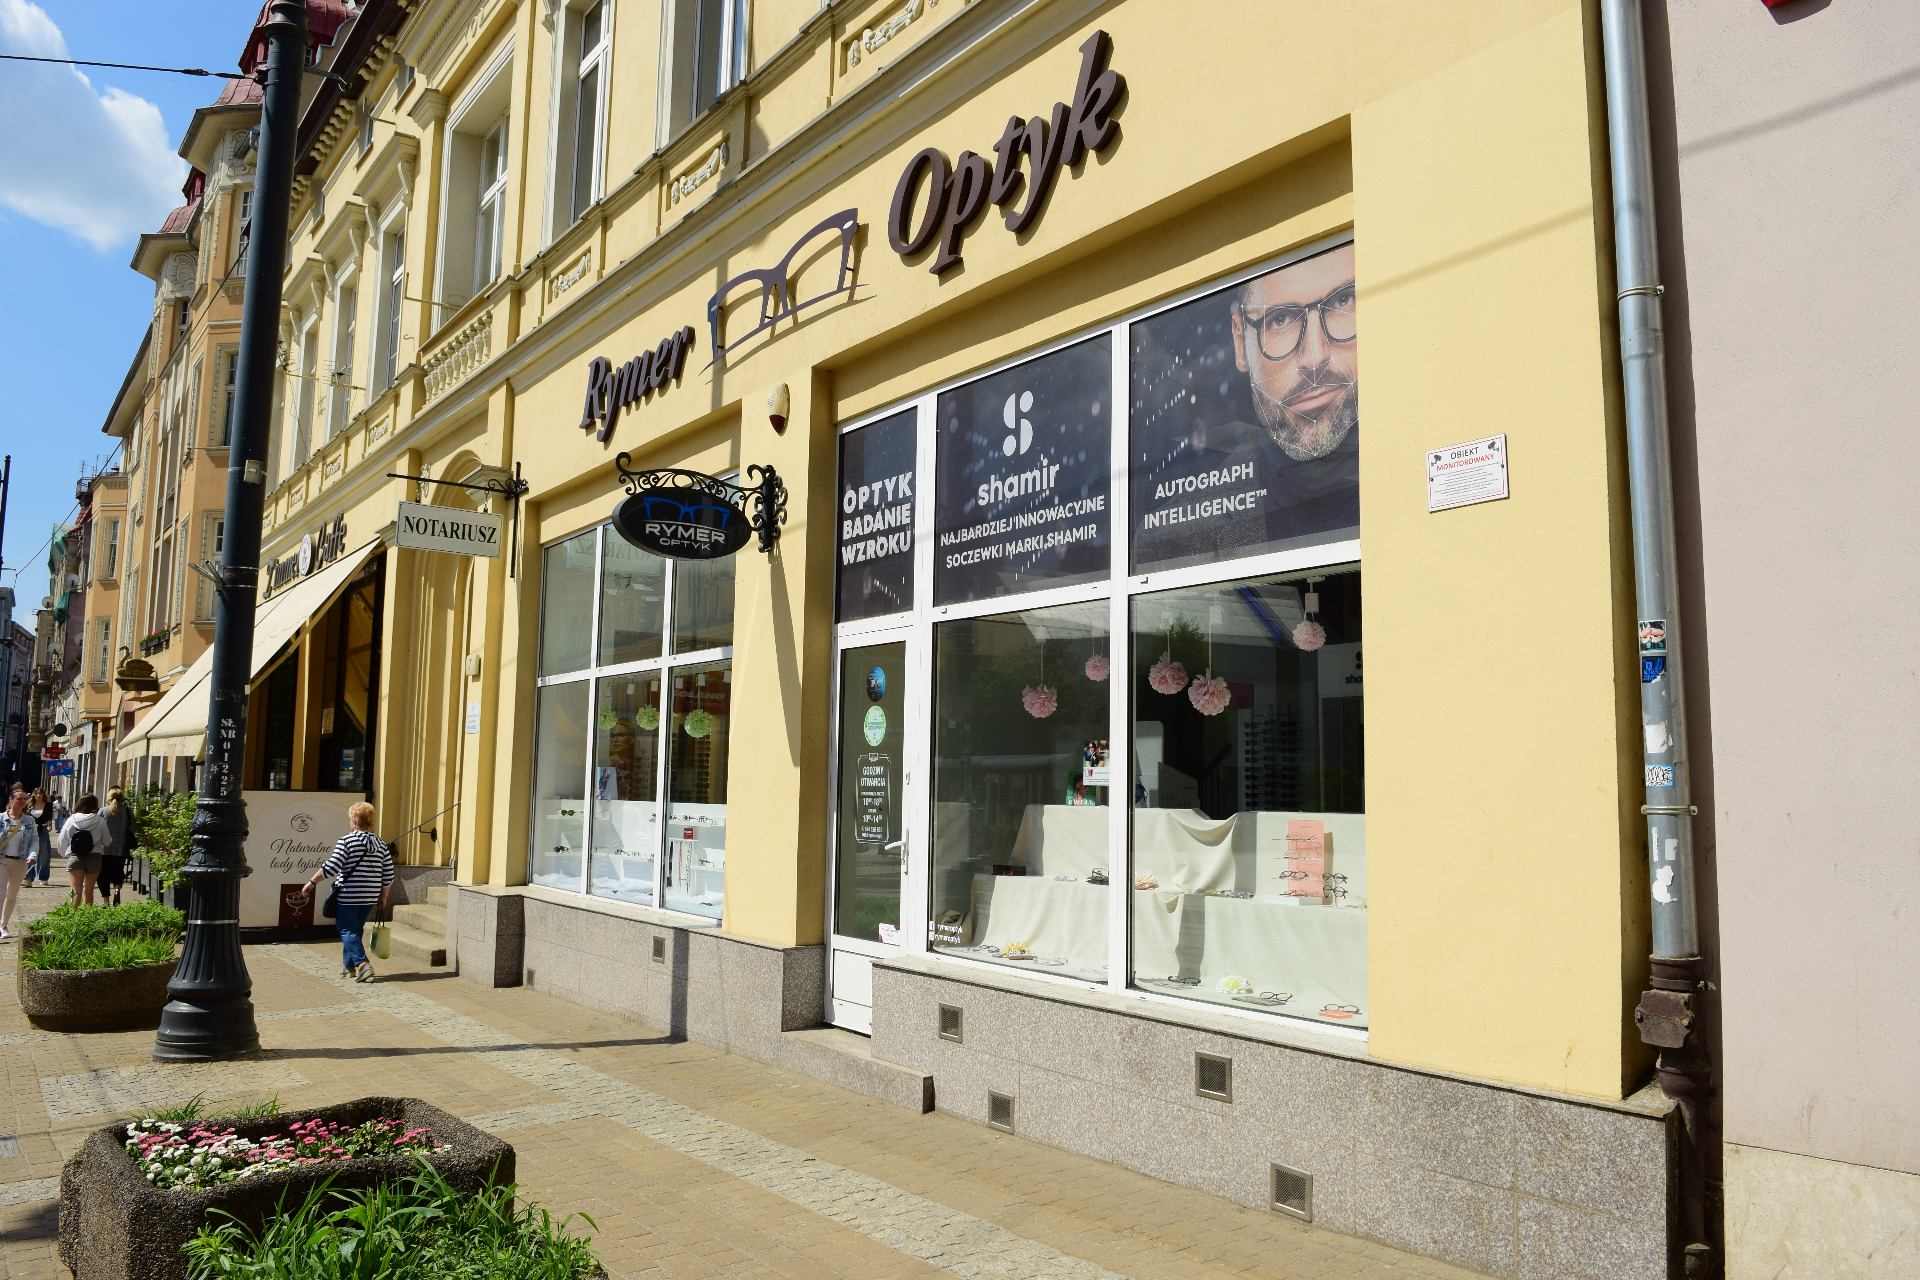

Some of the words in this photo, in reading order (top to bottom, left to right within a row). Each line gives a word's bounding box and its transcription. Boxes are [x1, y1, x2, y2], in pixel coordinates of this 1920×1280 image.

[579, 325, 696, 442] Rymer
[888, 29, 1127, 276] Optyk
[1436, 453, 1494, 471] MONITOROWANY
[1451, 447, 1478, 459] OBIEKT
[843, 471, 913, 514] OPTYK
[977, 458, 1060, 506] shamir
[1155, 461, 1254, 499] AUTOGRAPH
[403, 515, 497, 544] NOTARIUSZ
[645, 523, 725, 544] RYMER
[843, 503, 911, 540] BADANIE
[940, 518, 1013, 547] NAJBARDZIEJ
[1015, 495, 1105, 529] INNOWACYJNE
[660, 538, 711, 551] OPTYK
[841, 530, 912, 566] WZROKU
[946, 543, 1003, 568] SOCZEWKI
[1006, 535, 1044, 556] MARKI
[1046, 523, 1097, 547] SHAMIR
[220, 729, 236, 739] NR
[860, 778, 886, 787] OTWARCIA
[862, 766, 884, 776] GODZINY
[270, 838, 332, 855] Naturalne
[269, 857, 295, 873] lody
